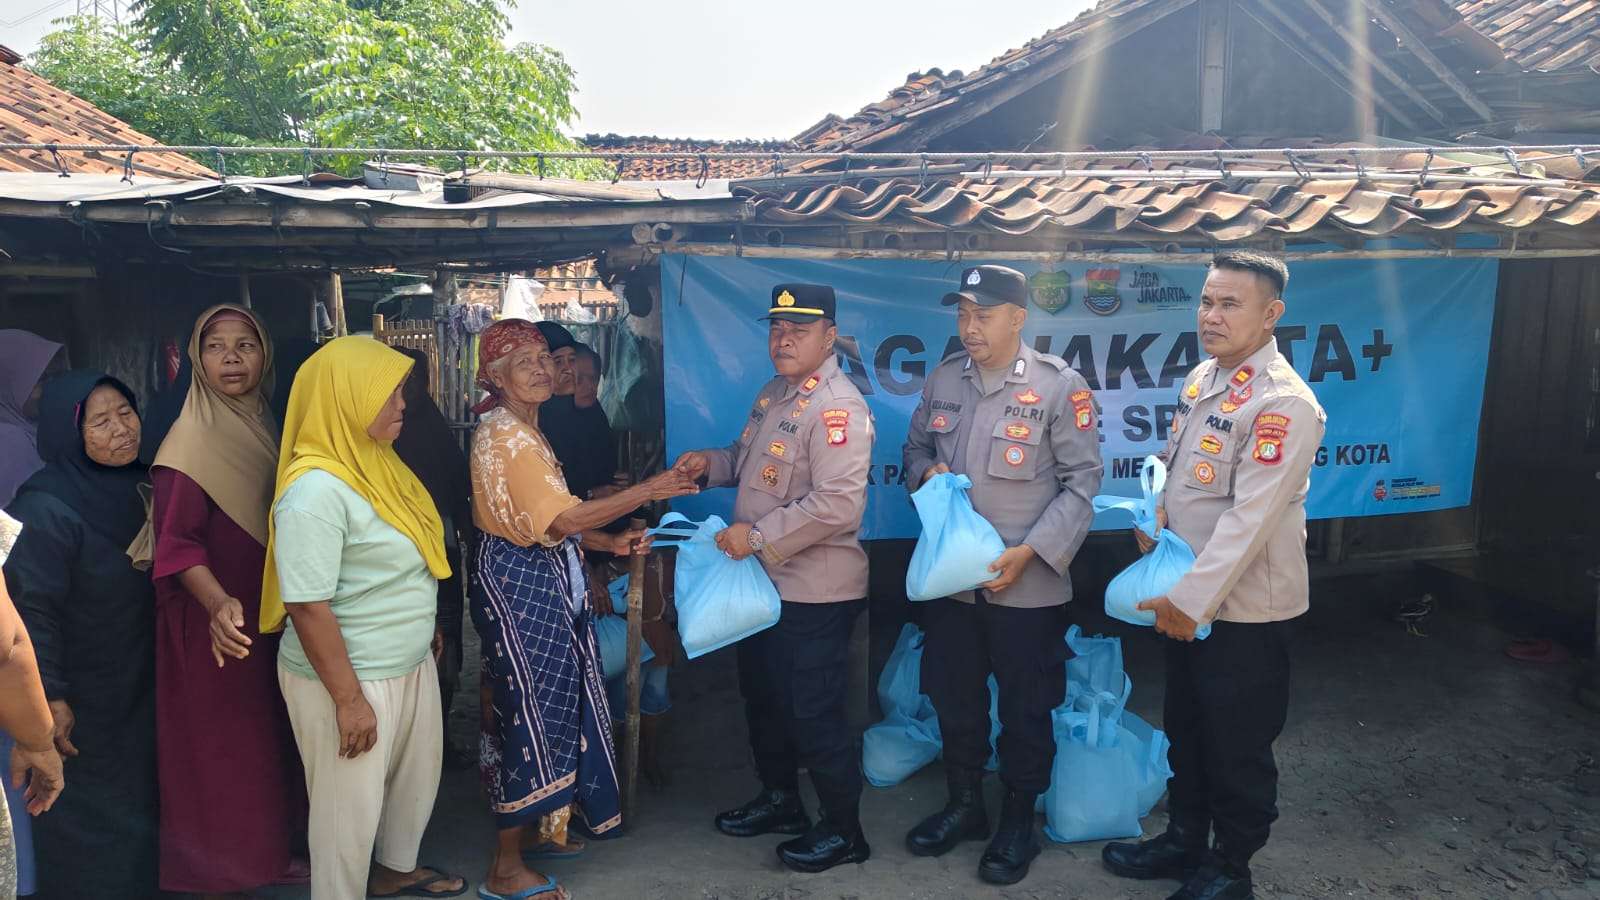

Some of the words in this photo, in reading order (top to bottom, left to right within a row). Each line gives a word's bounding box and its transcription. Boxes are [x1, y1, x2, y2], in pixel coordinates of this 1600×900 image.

[832, 334, 969, 396] AG
[1033, 324, 1393, 391] AKATA+
[1004, 405, 1044, 421] POLRI
[1122, 404, 1178, 442] SP
[777, 420, 798, 434] POLRI
[1205, 414, 1233, 434] POLRI
[1335, 444, 1391, 466] KOTA
